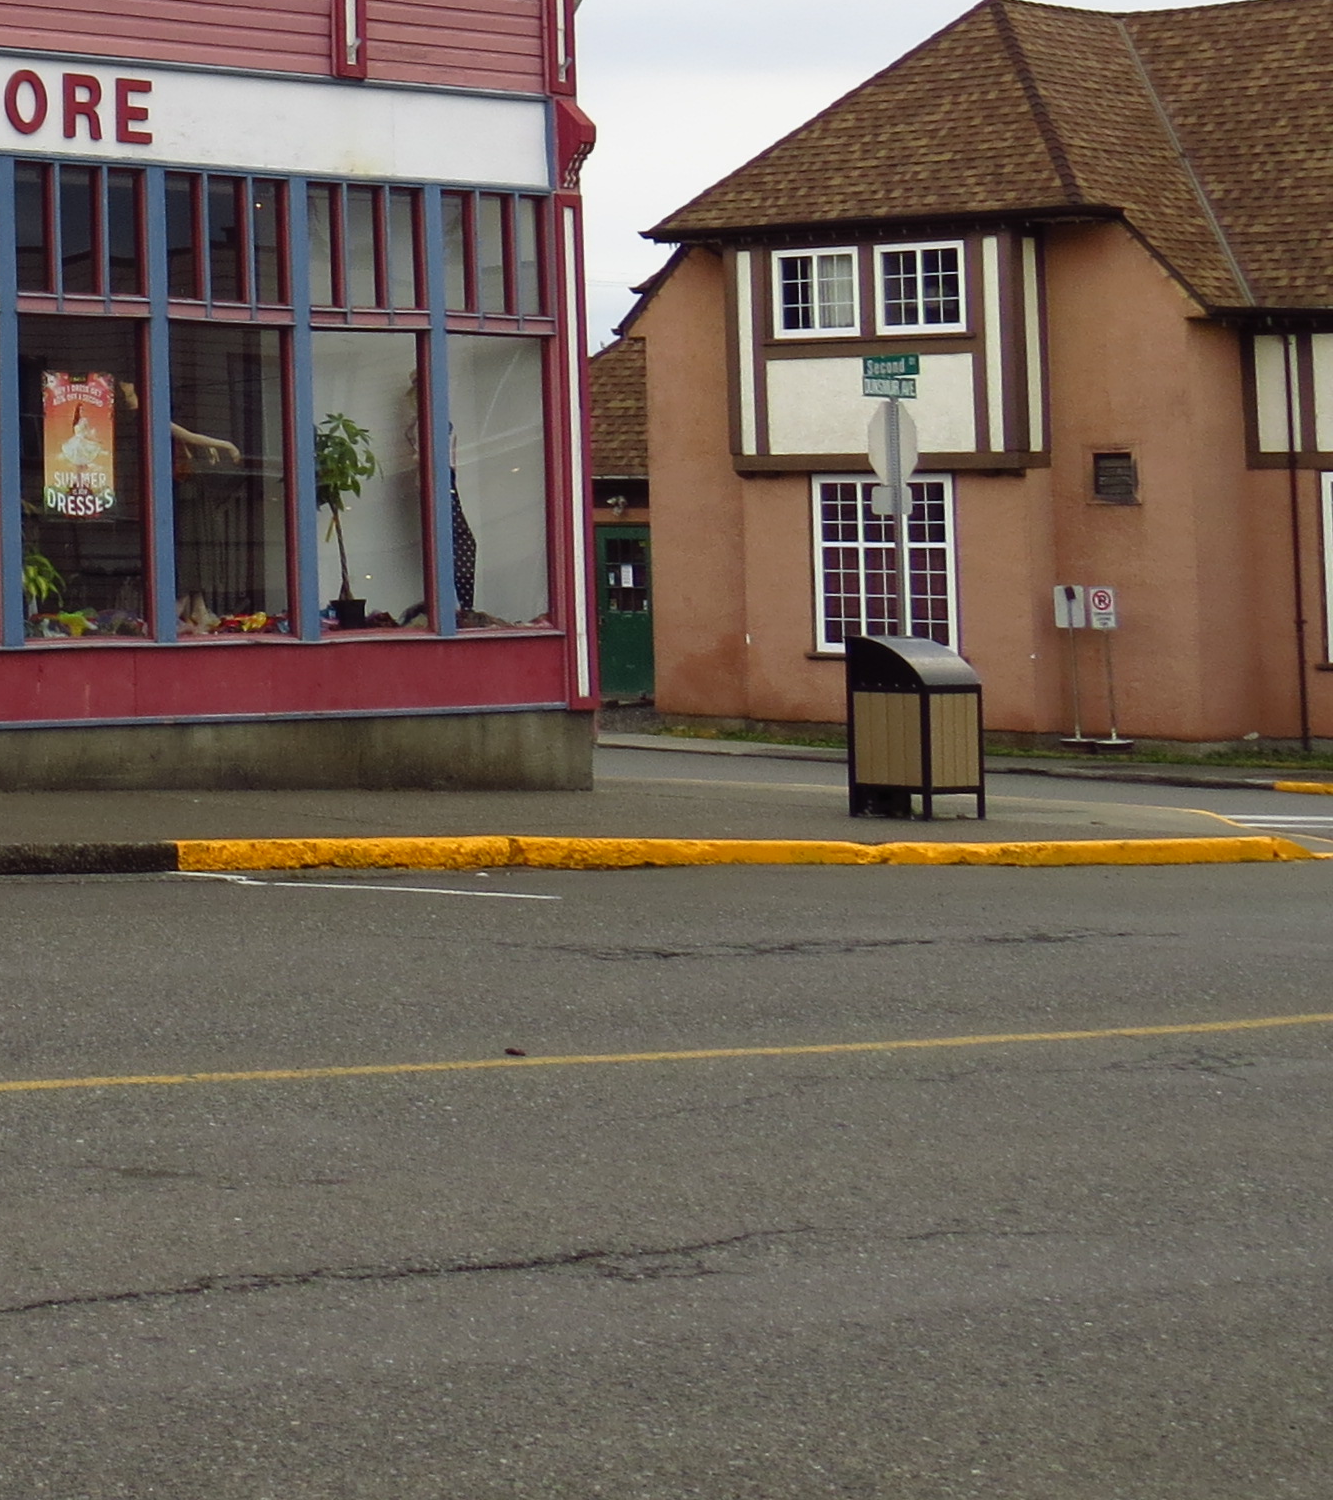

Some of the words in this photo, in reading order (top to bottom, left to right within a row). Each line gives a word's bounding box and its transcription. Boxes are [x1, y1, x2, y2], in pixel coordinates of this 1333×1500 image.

[866, 357, 905, 375] Second
[54, 471, 107, 488] SUMMER
[47, 487, 114, 516] DRESSES
